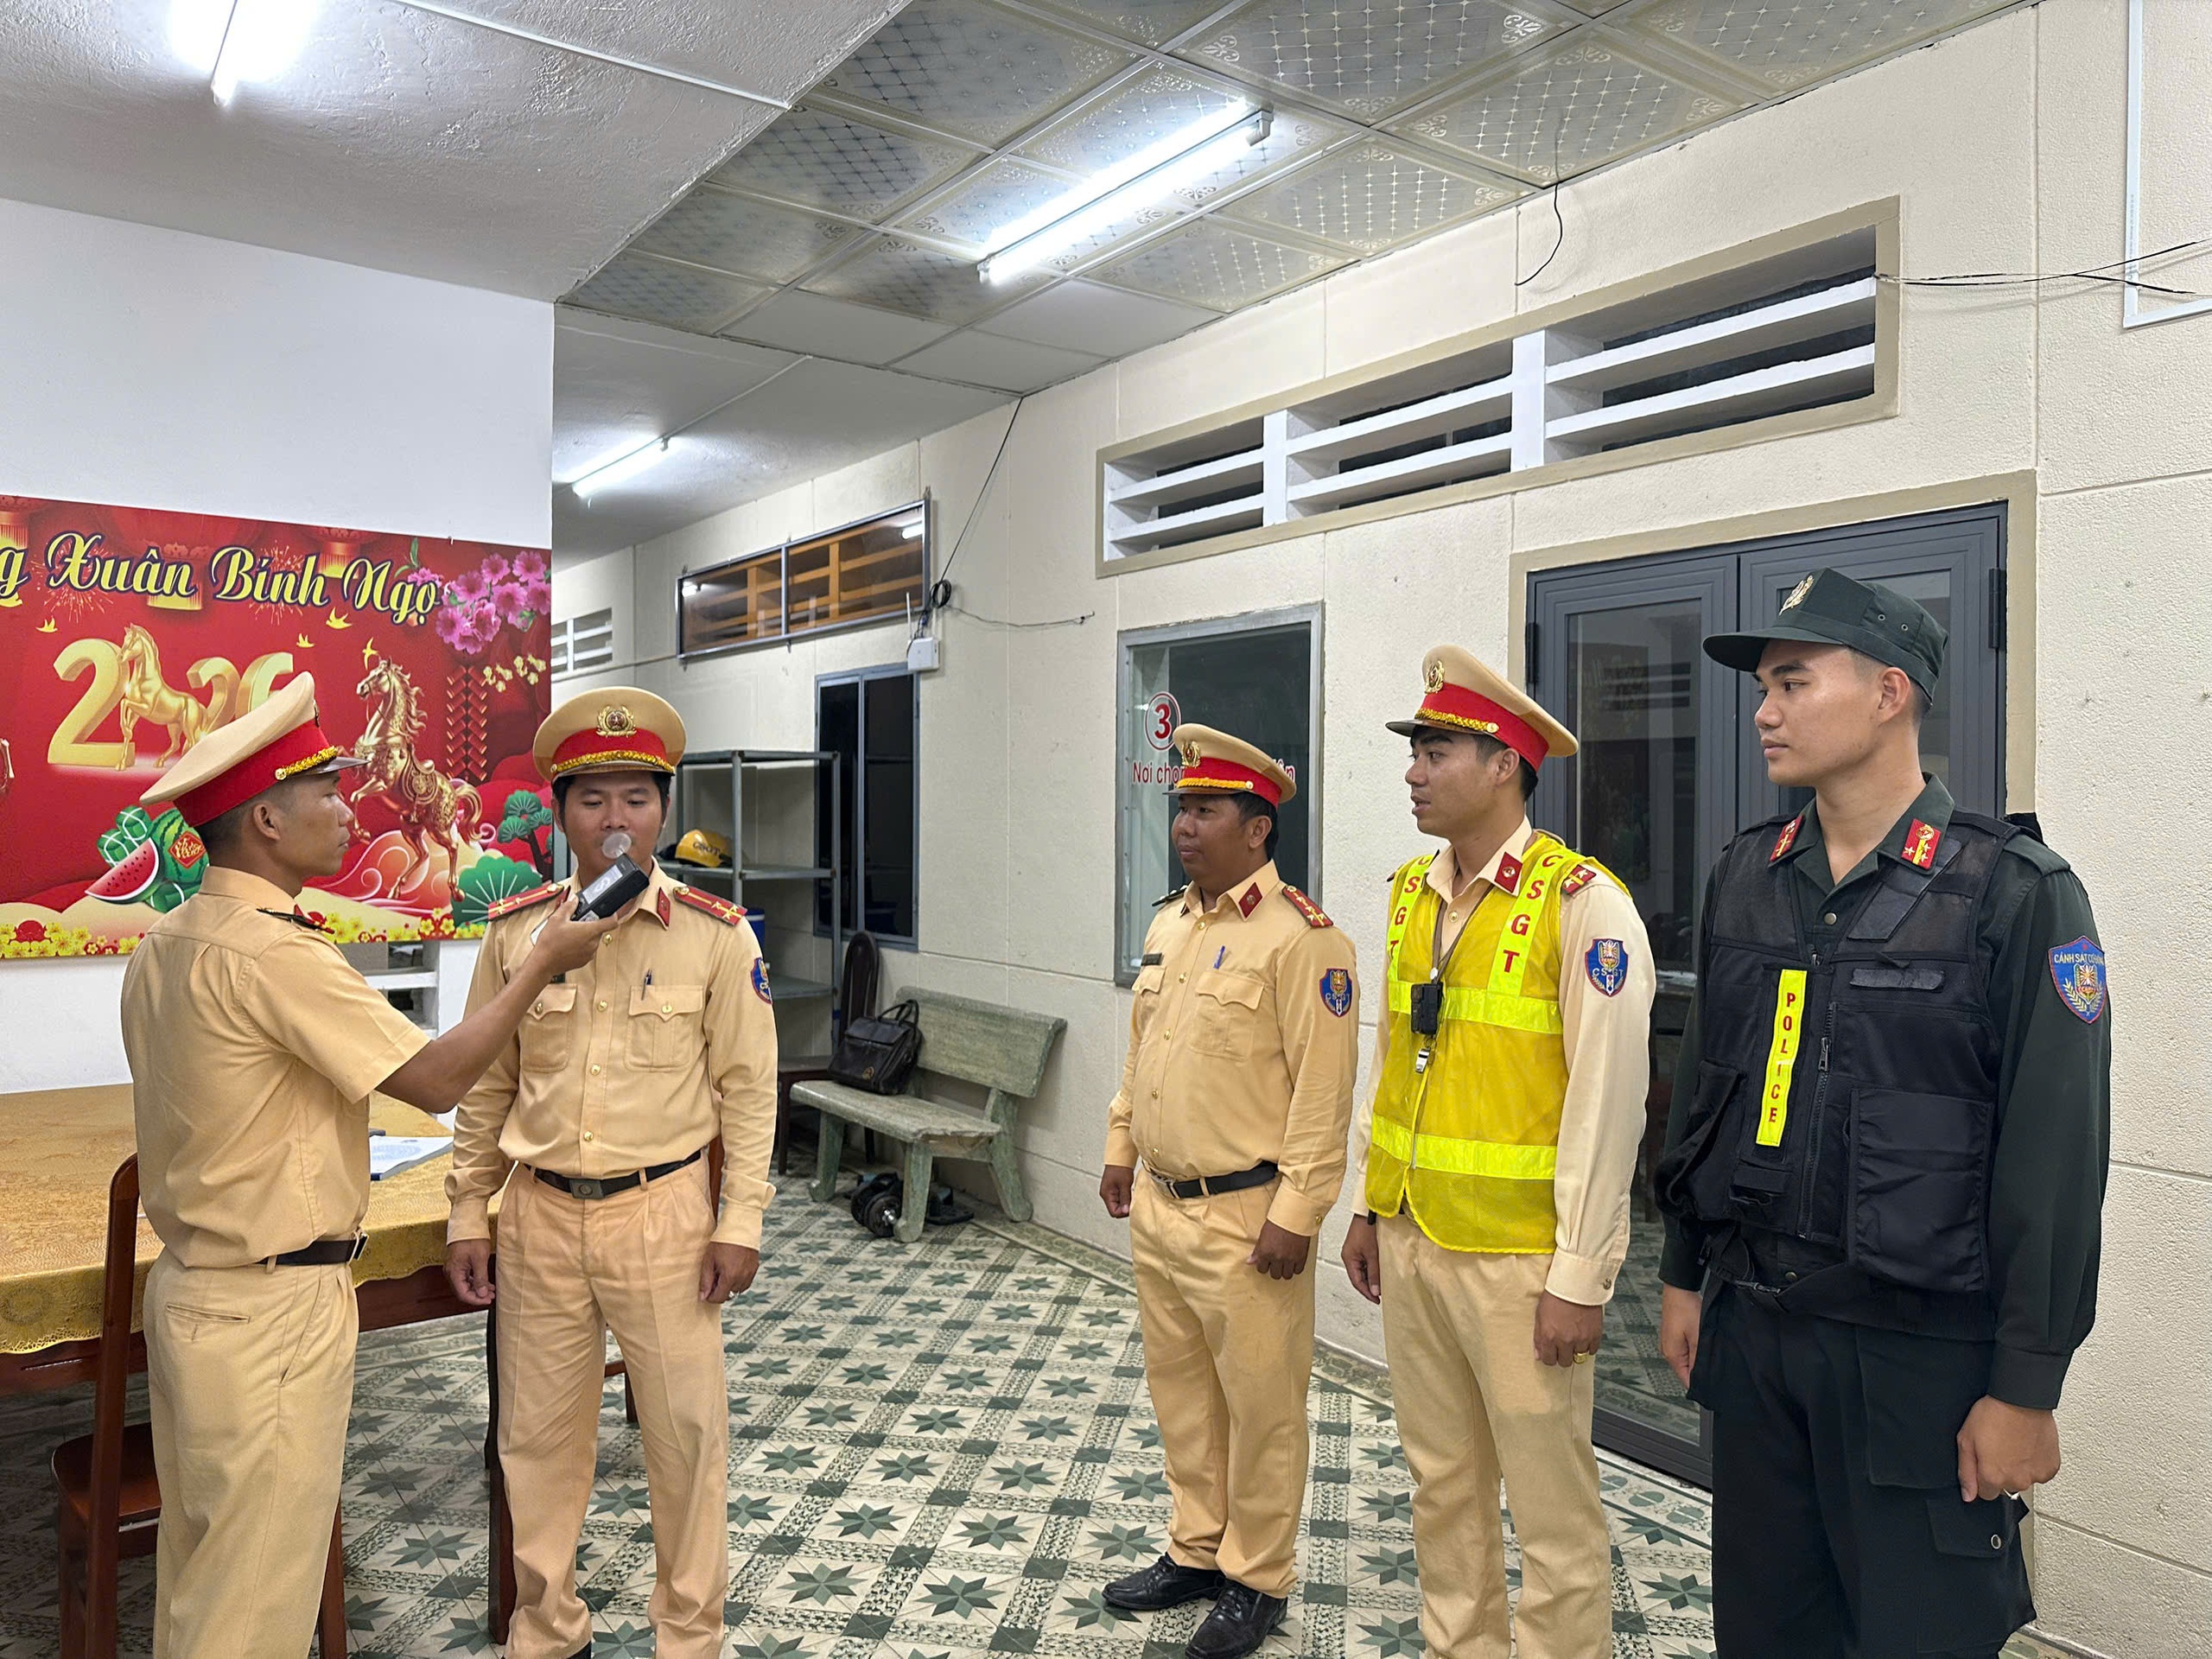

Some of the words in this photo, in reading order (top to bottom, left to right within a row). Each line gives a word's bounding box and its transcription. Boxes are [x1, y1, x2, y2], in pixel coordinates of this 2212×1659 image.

[47, 531, 199, 596] Xuân
[211, 545, 330, 607] Bính
[341, 557, 439, 626] Ngọ
[1154, 703, 1172, 740] 3
[1503, 854, 1564, 973] CSGT
[1769, 992, 1796, 1122] POLICE
